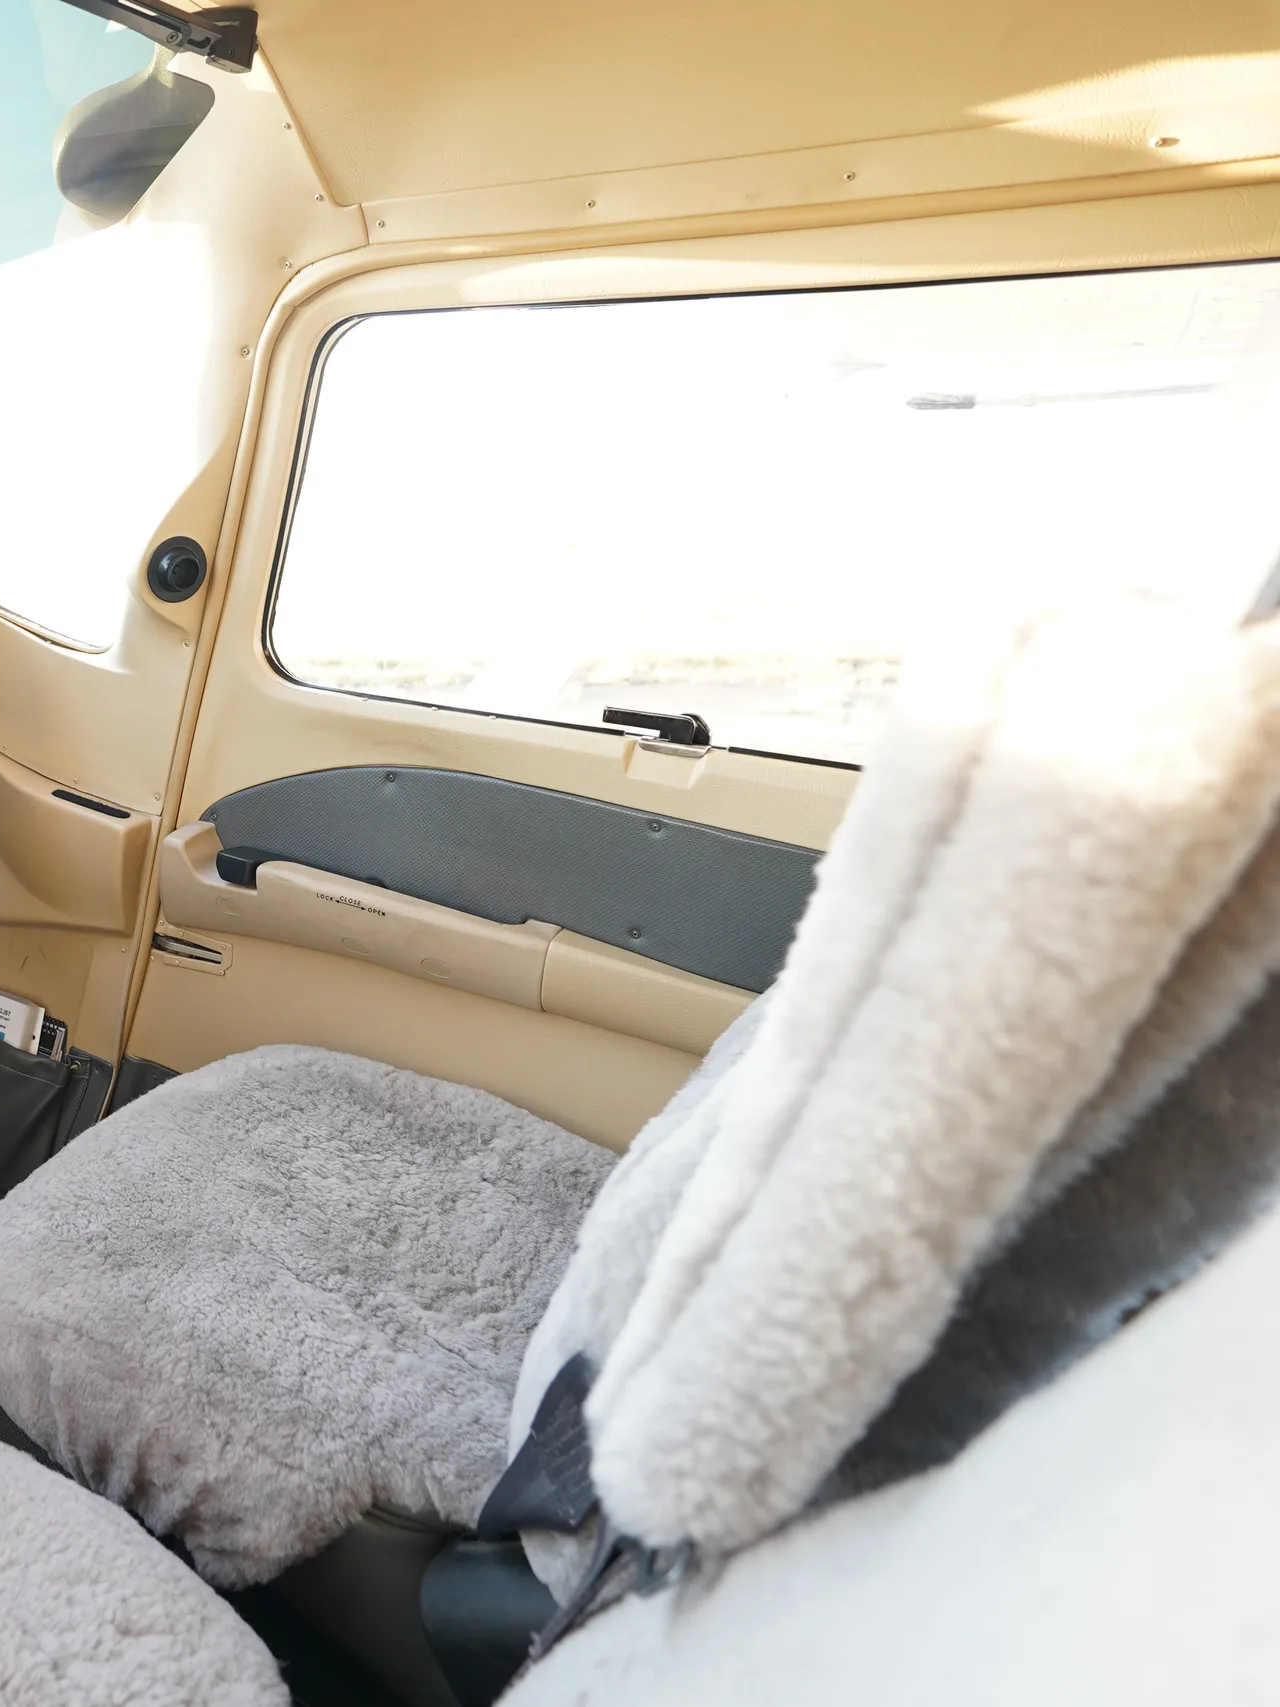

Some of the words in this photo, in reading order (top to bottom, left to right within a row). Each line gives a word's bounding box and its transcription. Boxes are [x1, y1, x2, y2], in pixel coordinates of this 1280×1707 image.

[317, 893, 333, 901] LOCK
[340, 896, 361, 906] CLOSE
[368, 908, 385, 916] OPEN
